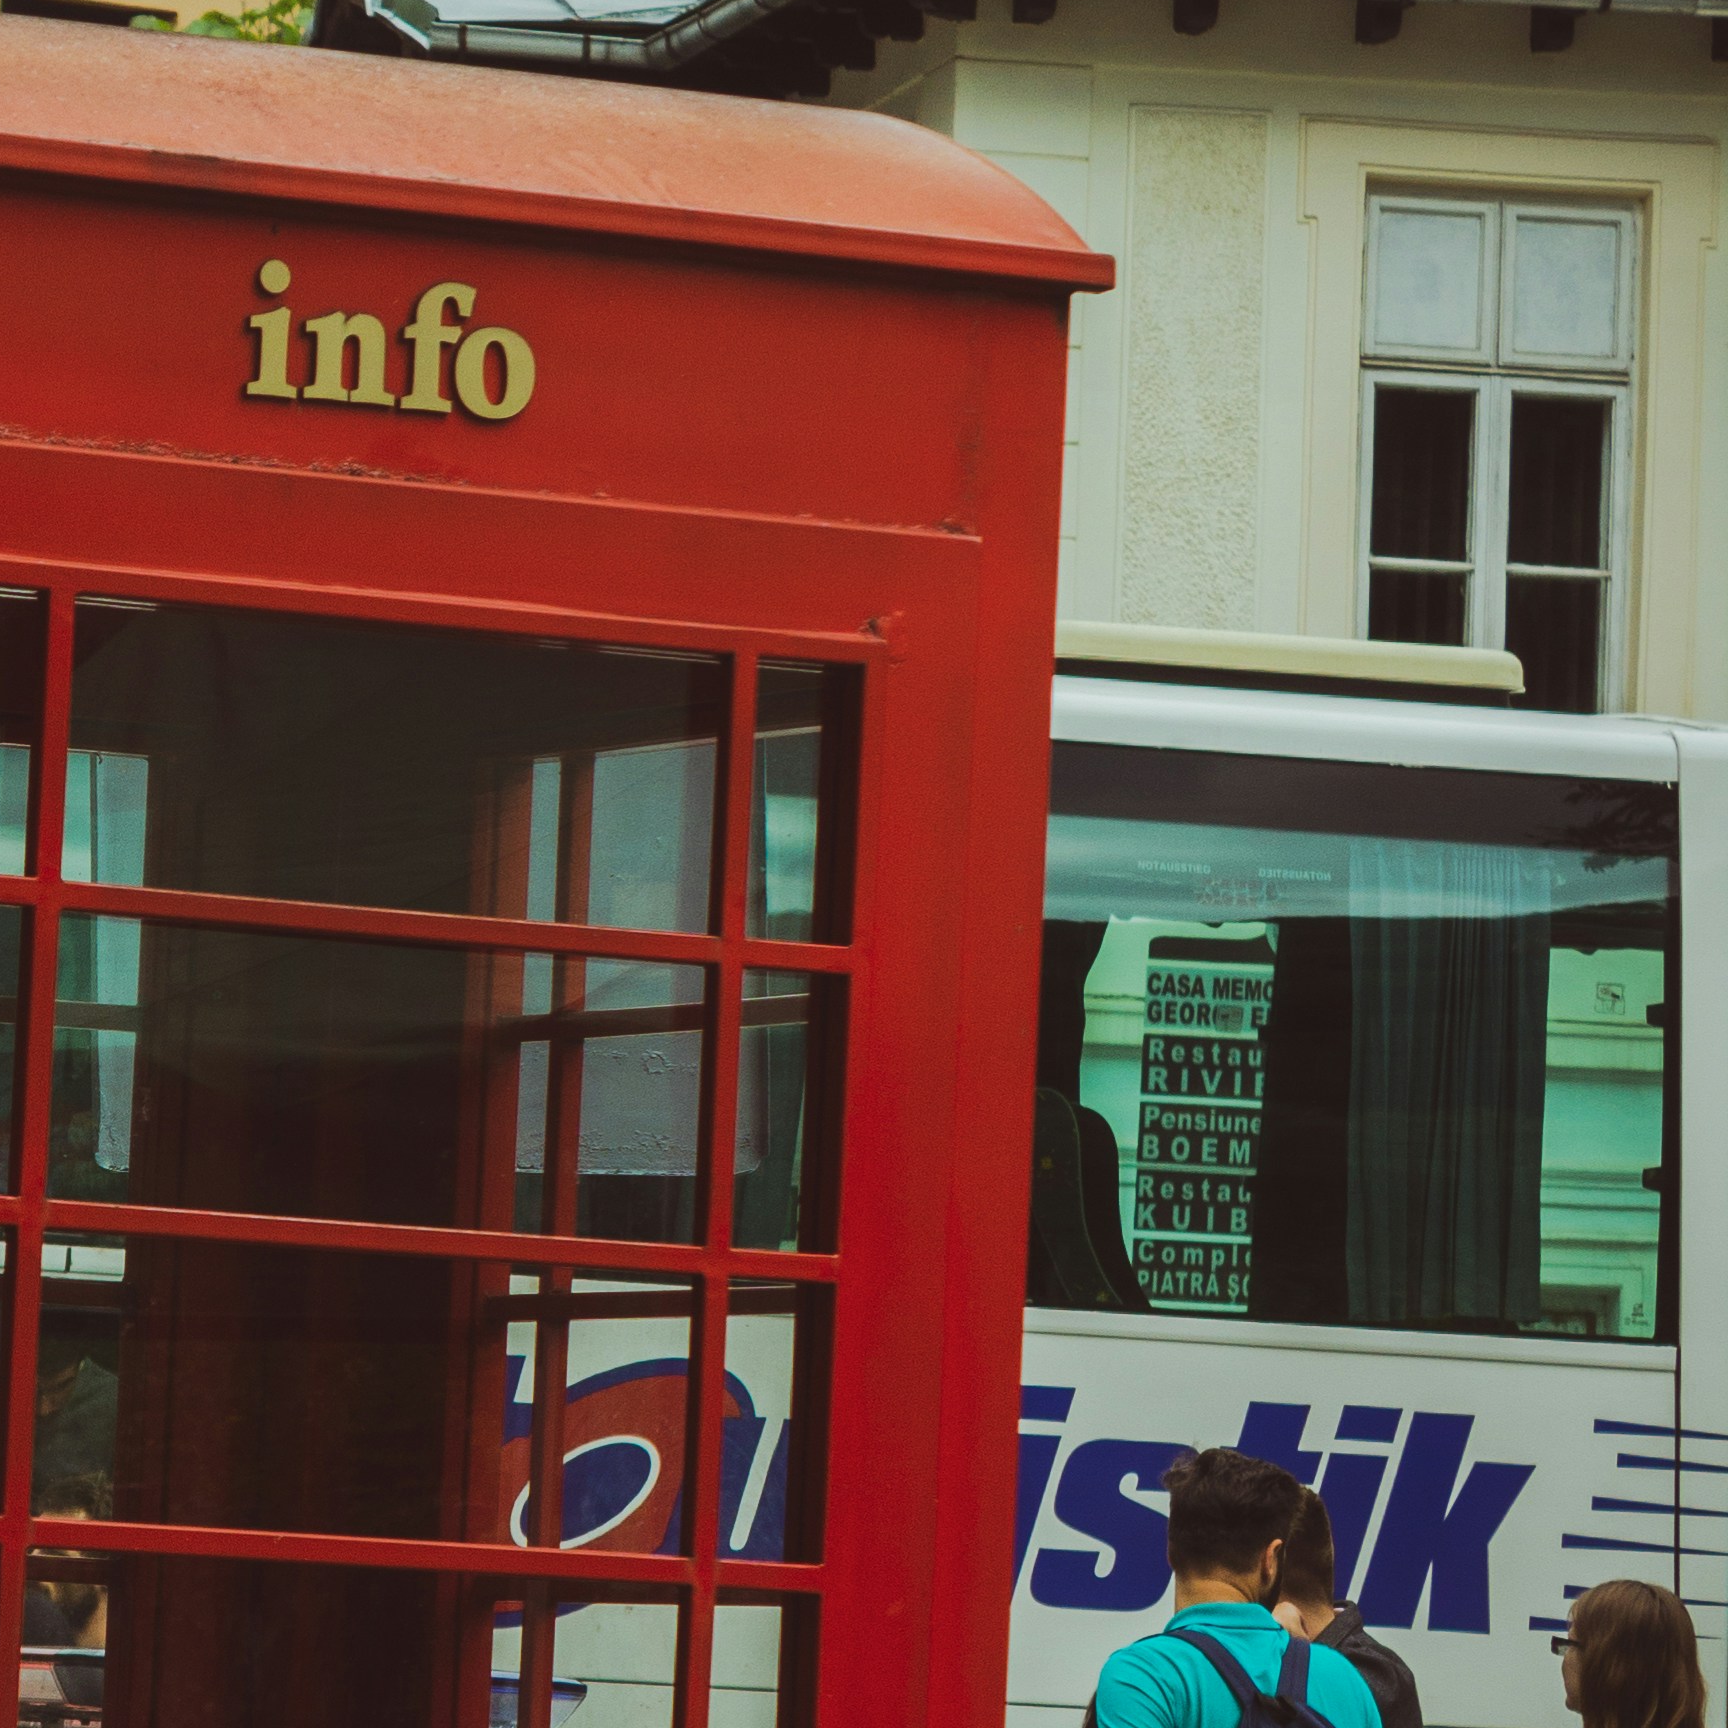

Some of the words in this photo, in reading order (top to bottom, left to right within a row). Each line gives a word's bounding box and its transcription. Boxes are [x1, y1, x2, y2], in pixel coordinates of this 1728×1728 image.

[246, 259, 536, 420] info
[1147, 973, 1206, 999] CASA
[1146, 1000, 1232, 1026] GEOR
[1250, 1006, 1272, 1030] E
[1148, 1037, 1263, 1066] Restau
[1144, 1105, 1262, 1135] Pensiune
[1142, 1134, 1251, 1165] BOEM
[1136, 1203, 1248, 1233] KUIB
[1137, 1269, 1220, 1297] PIATRA
